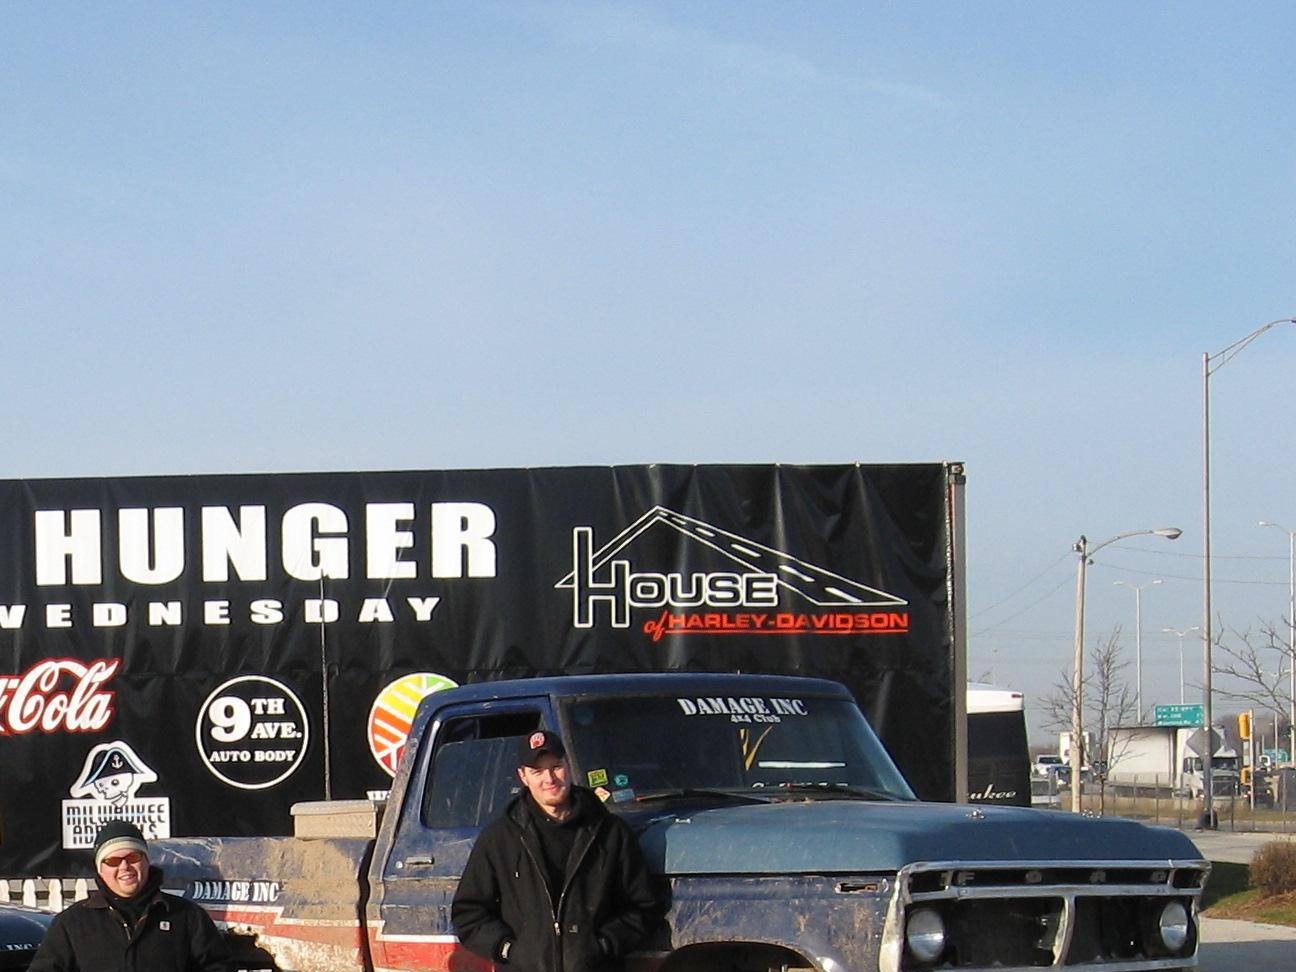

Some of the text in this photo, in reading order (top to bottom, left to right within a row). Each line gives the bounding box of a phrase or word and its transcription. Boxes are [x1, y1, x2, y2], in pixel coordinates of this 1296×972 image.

[35, 501, 497, 586] HUNGER
[573, 527, 778, 628] HOUSE
[643, 611, 909, 641] of HARLEY-DAVIDSON
[677, 697, 809, 716] DAMAGE INC
[208, 696, 285, 742] 9 TH
[754, 713, 781, 723] Club
[251, 722, 302, 739] AVE.
[210, 750, 296, 762] AUTO BODY
[192, 881, 280, 902] DAMAGE INC
